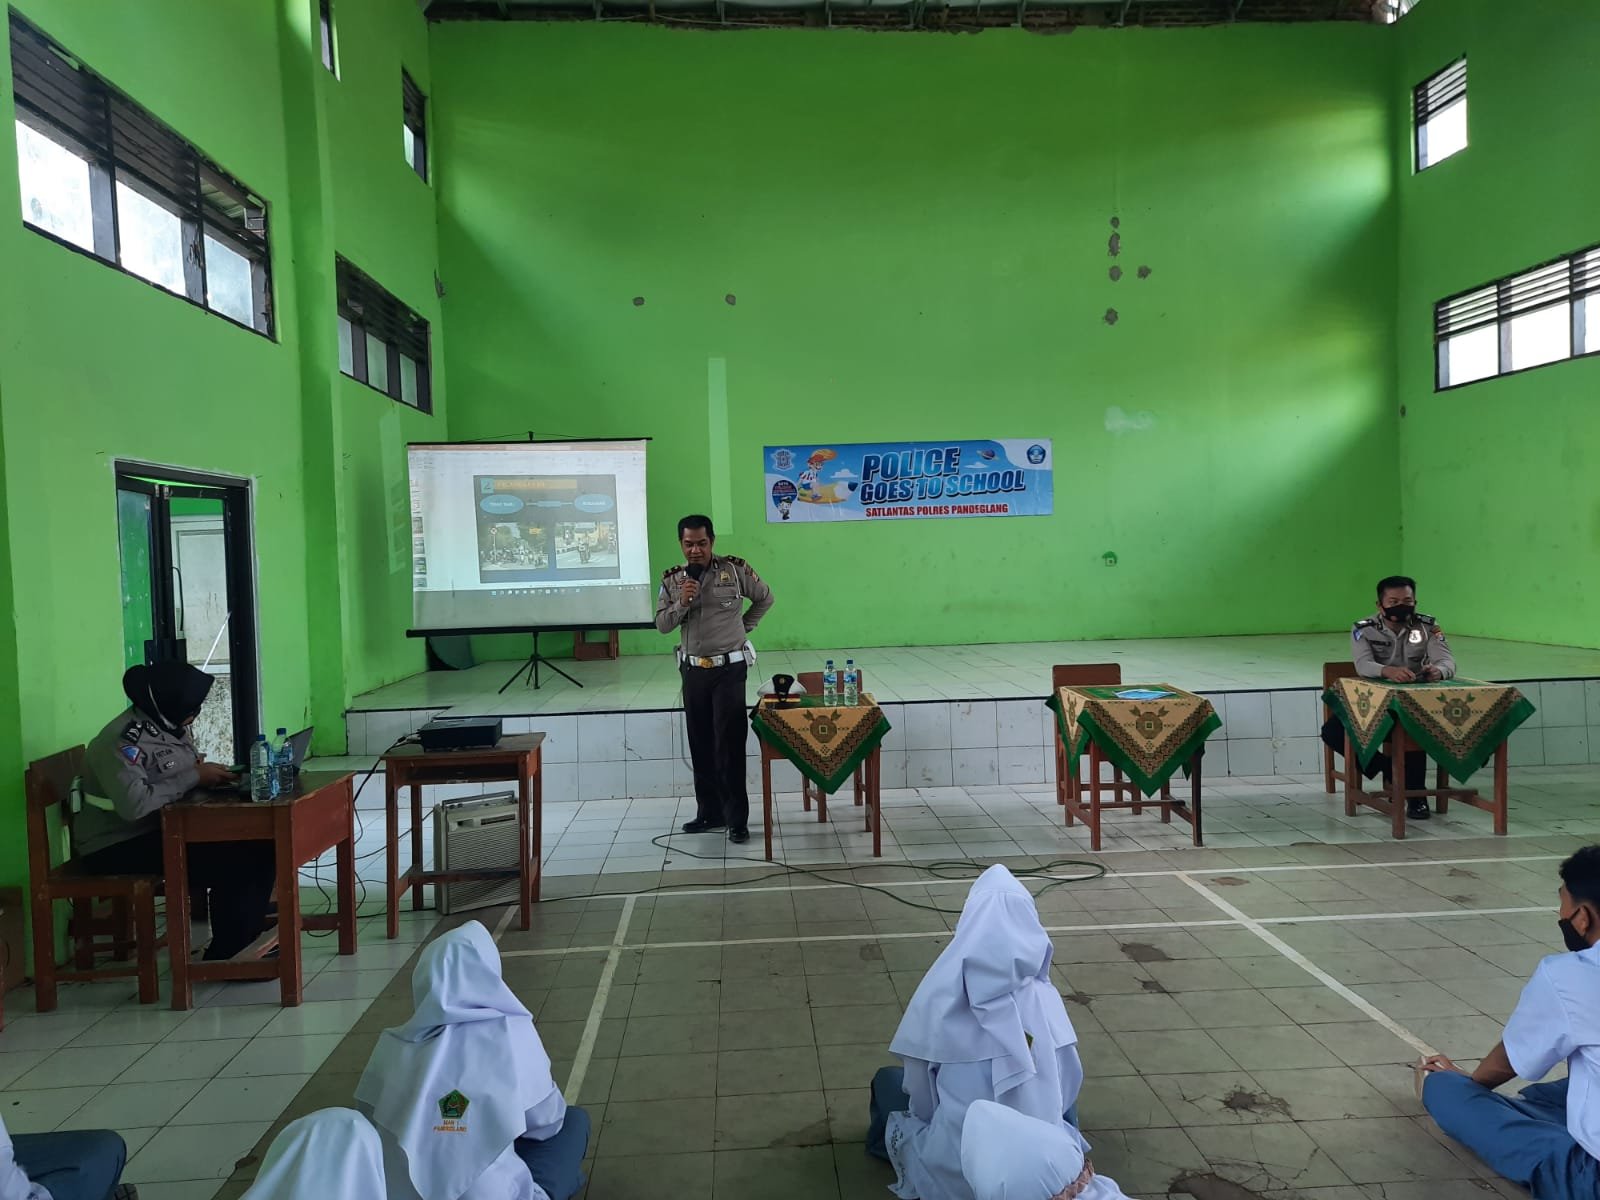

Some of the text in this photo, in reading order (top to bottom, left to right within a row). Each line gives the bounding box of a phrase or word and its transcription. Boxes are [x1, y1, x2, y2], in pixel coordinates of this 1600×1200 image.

[862, 447, 960, 481] POLICE
[860, 469, 1025, 504] GOES TO SCHOOL
[866, 503, 1008, 517] SATLANTAS POLRES PANDEGLANG
